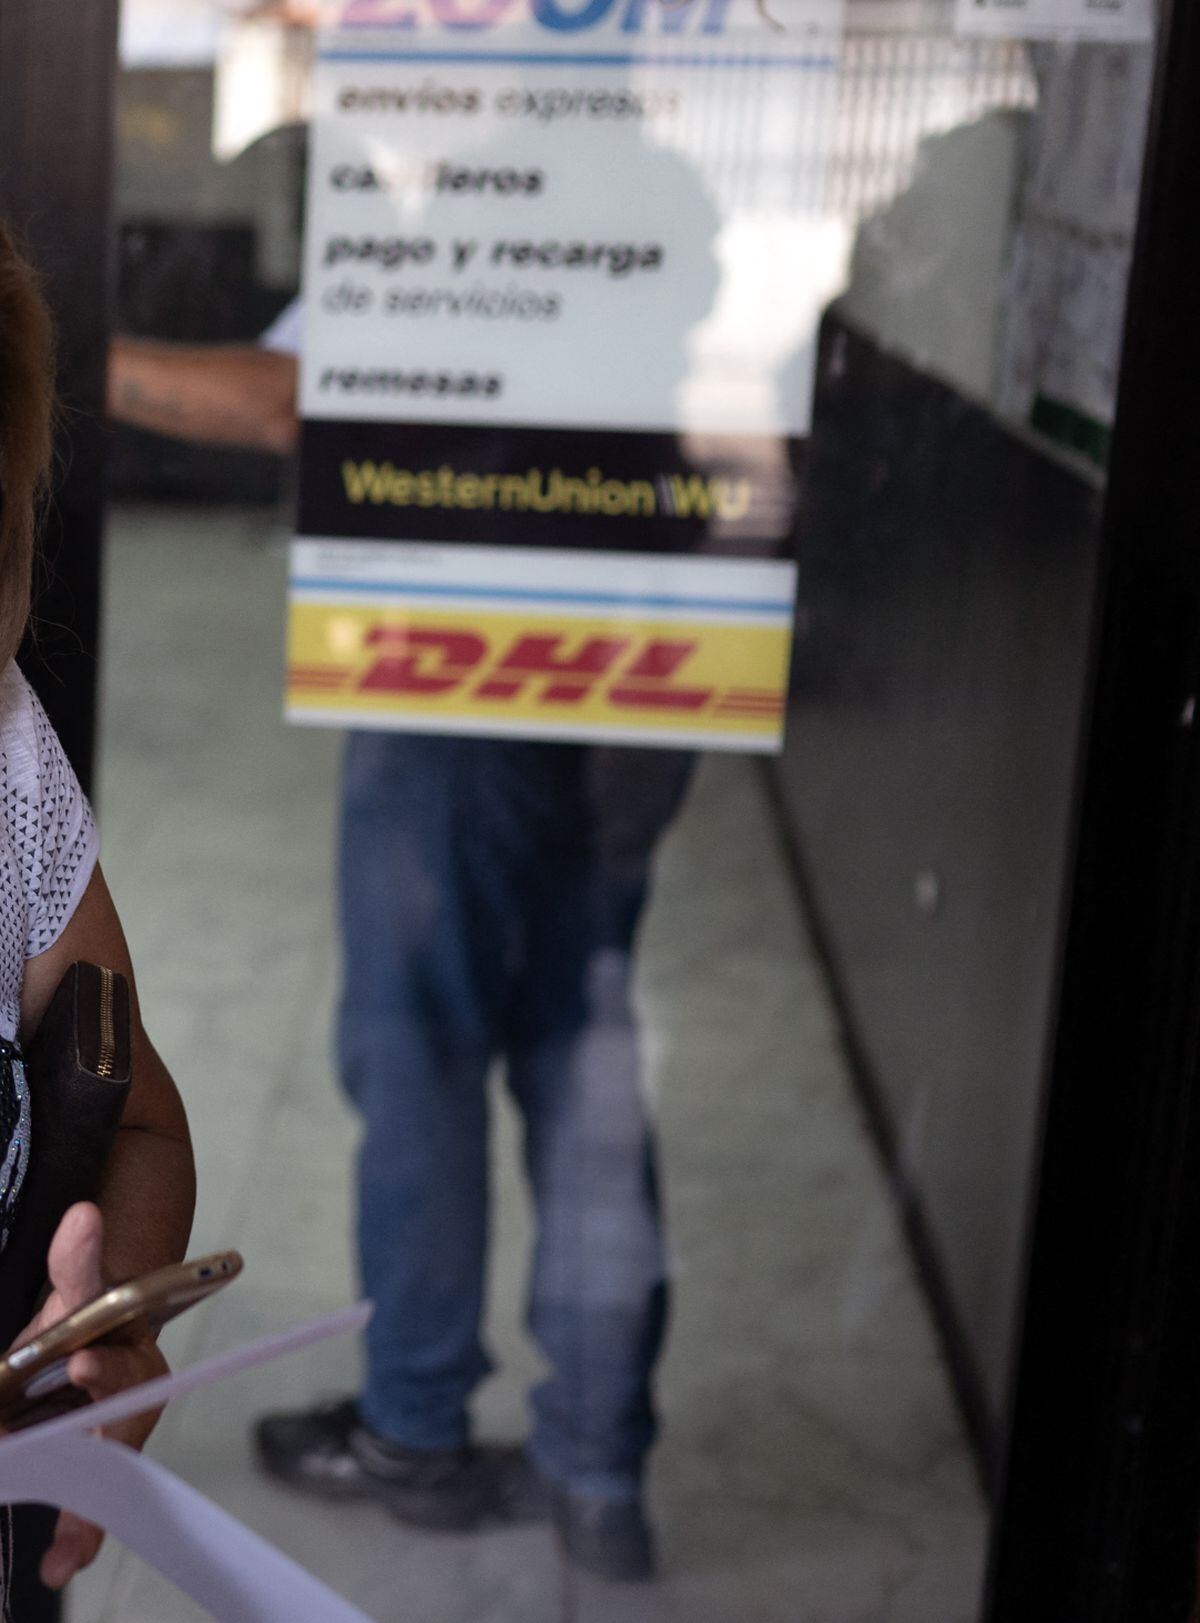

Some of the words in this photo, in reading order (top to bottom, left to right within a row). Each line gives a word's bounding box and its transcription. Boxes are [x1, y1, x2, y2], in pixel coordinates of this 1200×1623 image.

[323, 235, 436, 275] pago
[450, 238, 477, 273] y
[491, 238, 664, 279] recarga
[321, 280, 371, 317] de
[380, 281, 563, 323] servicios
[318, 366, 503, 400] remesas
[356, 627, 714, 712] DHL
